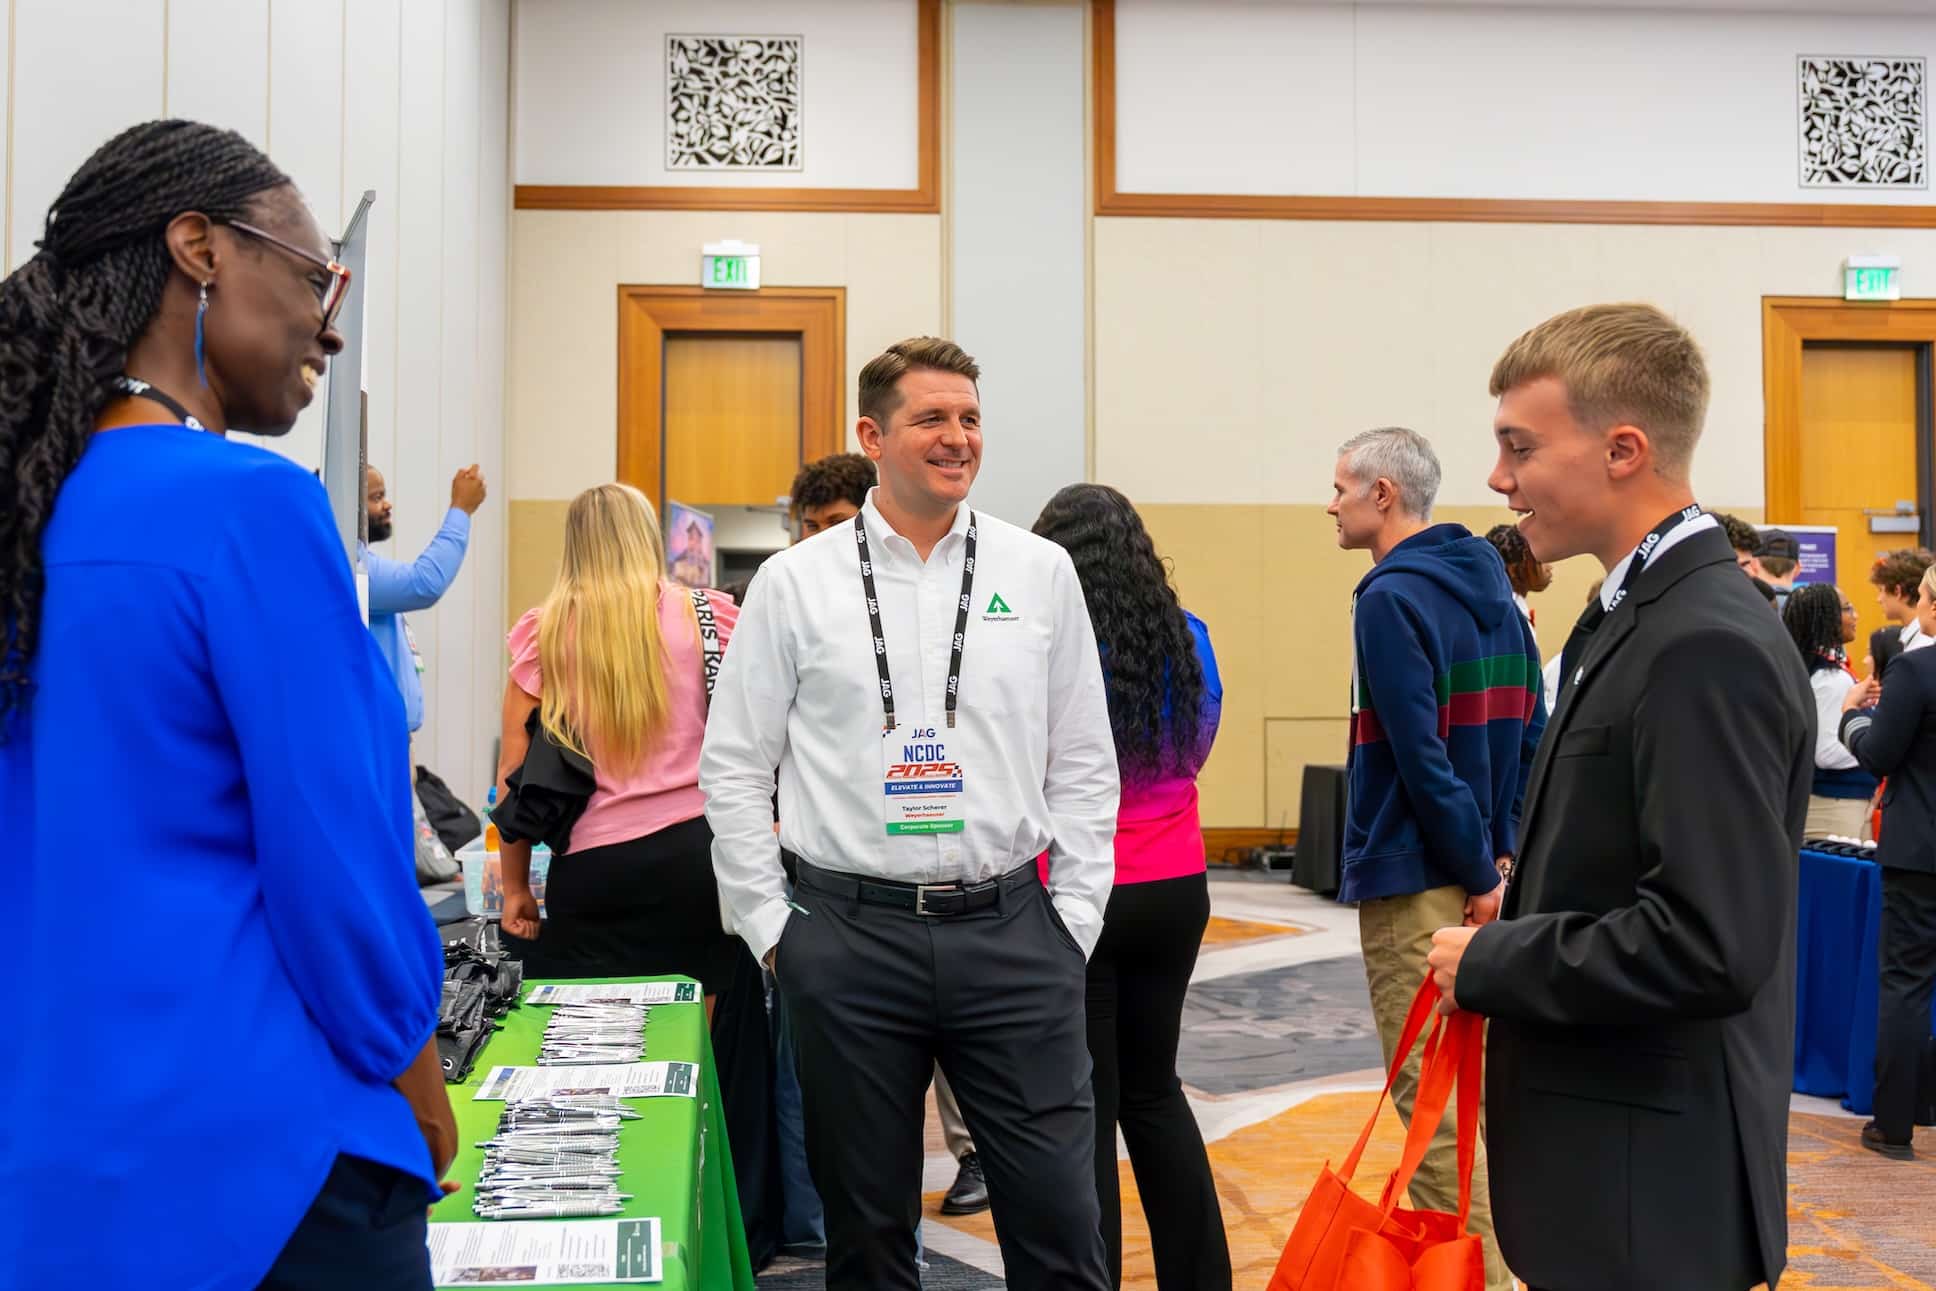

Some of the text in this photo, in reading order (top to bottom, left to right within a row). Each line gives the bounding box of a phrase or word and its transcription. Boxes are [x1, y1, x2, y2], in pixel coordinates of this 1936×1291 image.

[713, 256, 749, 283] EXIT
[1856, 268, 1891, 294] EXIT
[1638, 533, 1660, 559] JAG
[861, 561, 872, 576] JAG
[965, 557, 975, 574] JAG
[867, 598, 878, 615] JAG
[959, 594, 970, 612] JAG
[692, 590, 721, 694] PARIS KAR
[874, 636, 885, 655] JAG
[953, 632, 964, 652] JAG
[881, 678, 892, 697] JAG
[947, 675, 958, 695] JAG
[912, 728, 936, 739] JAG
[903, 744, 945, 762] NCDC
[886, 763, 956, 778] 2025
